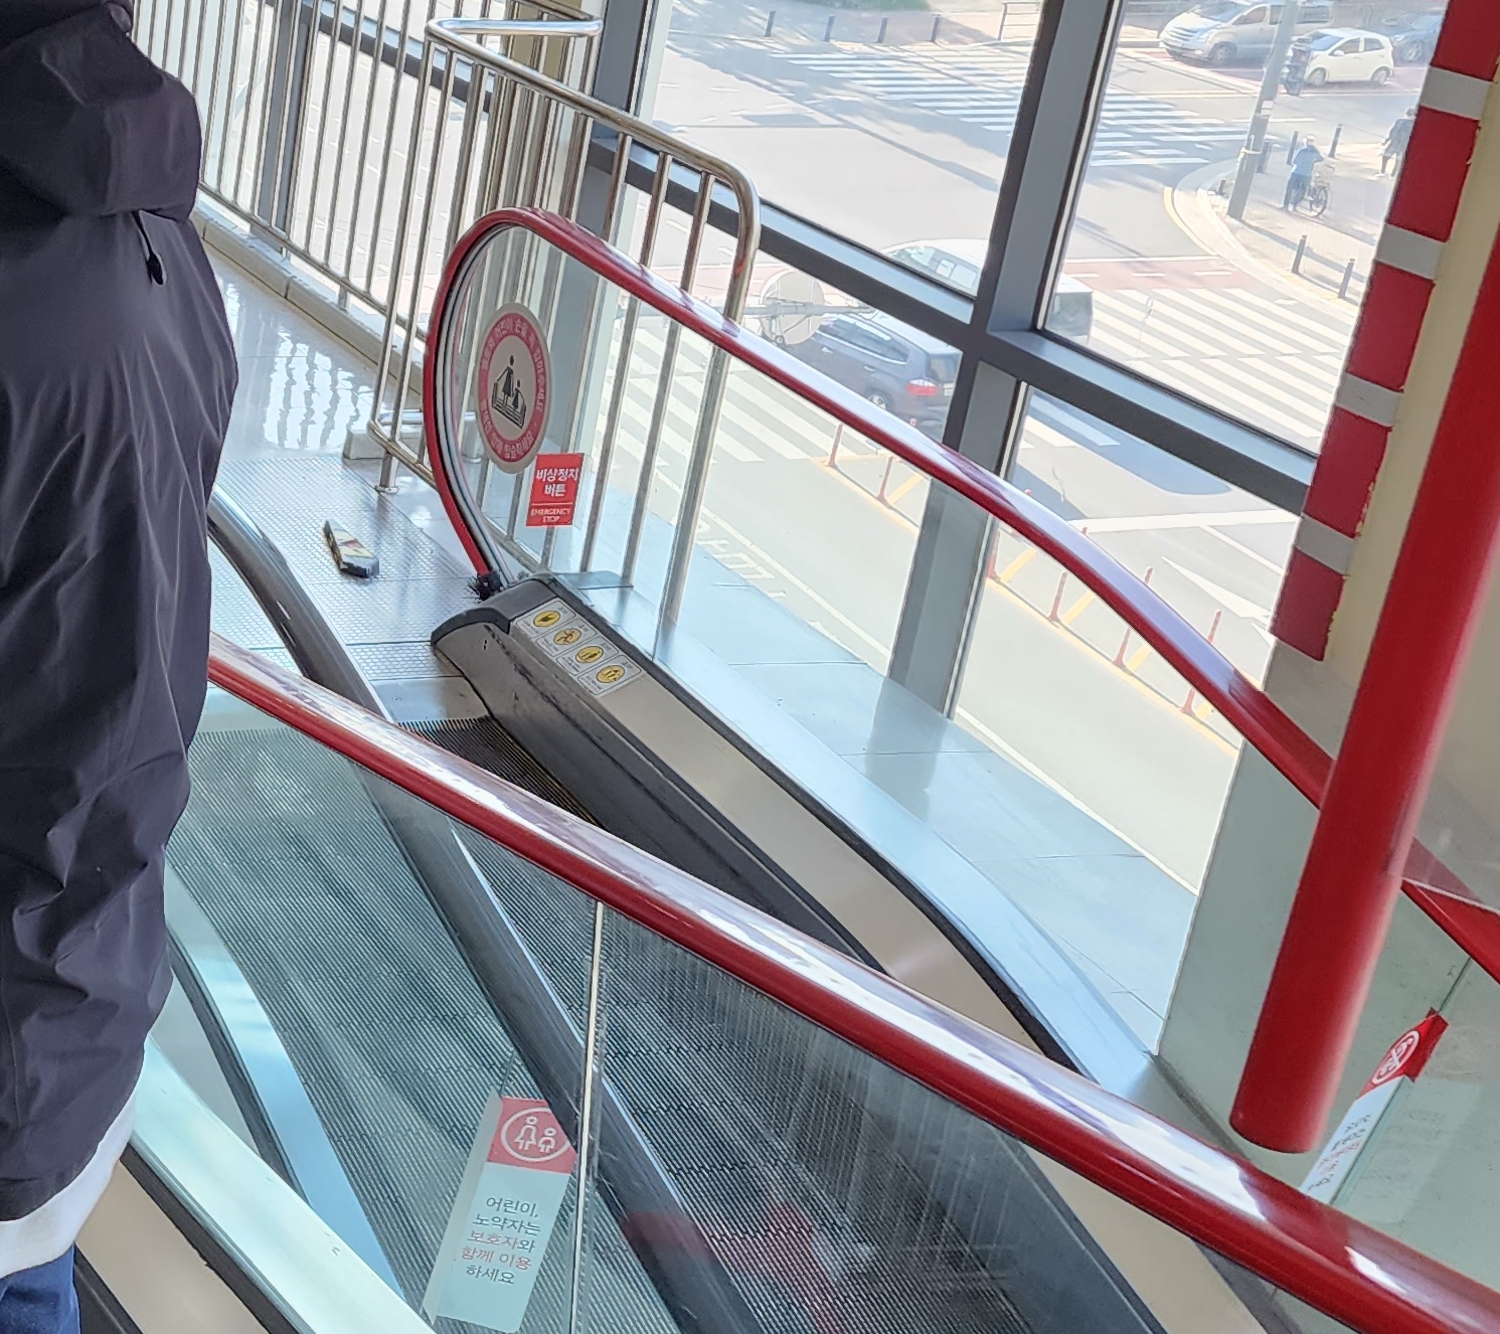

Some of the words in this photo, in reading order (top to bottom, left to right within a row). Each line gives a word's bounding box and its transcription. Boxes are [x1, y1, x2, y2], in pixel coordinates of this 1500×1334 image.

[536, 467, 579, 482] 비상정지
[544, 483, 566, 497] 버튼
[531, 507, 572, 517] EMERGENCY
[541, 516, 560, 524] STOP
[486, 1196, 539, 1218] 어린이,
[472, 1214, 541, 1237] 노약자는
[467, 1230, 536, 1254] 보호자와
[461, 1245, 494, 1263] 함께
[499, 1250, 531, 1270] 이용
[466, 1264, 515, 1286] 하세요
